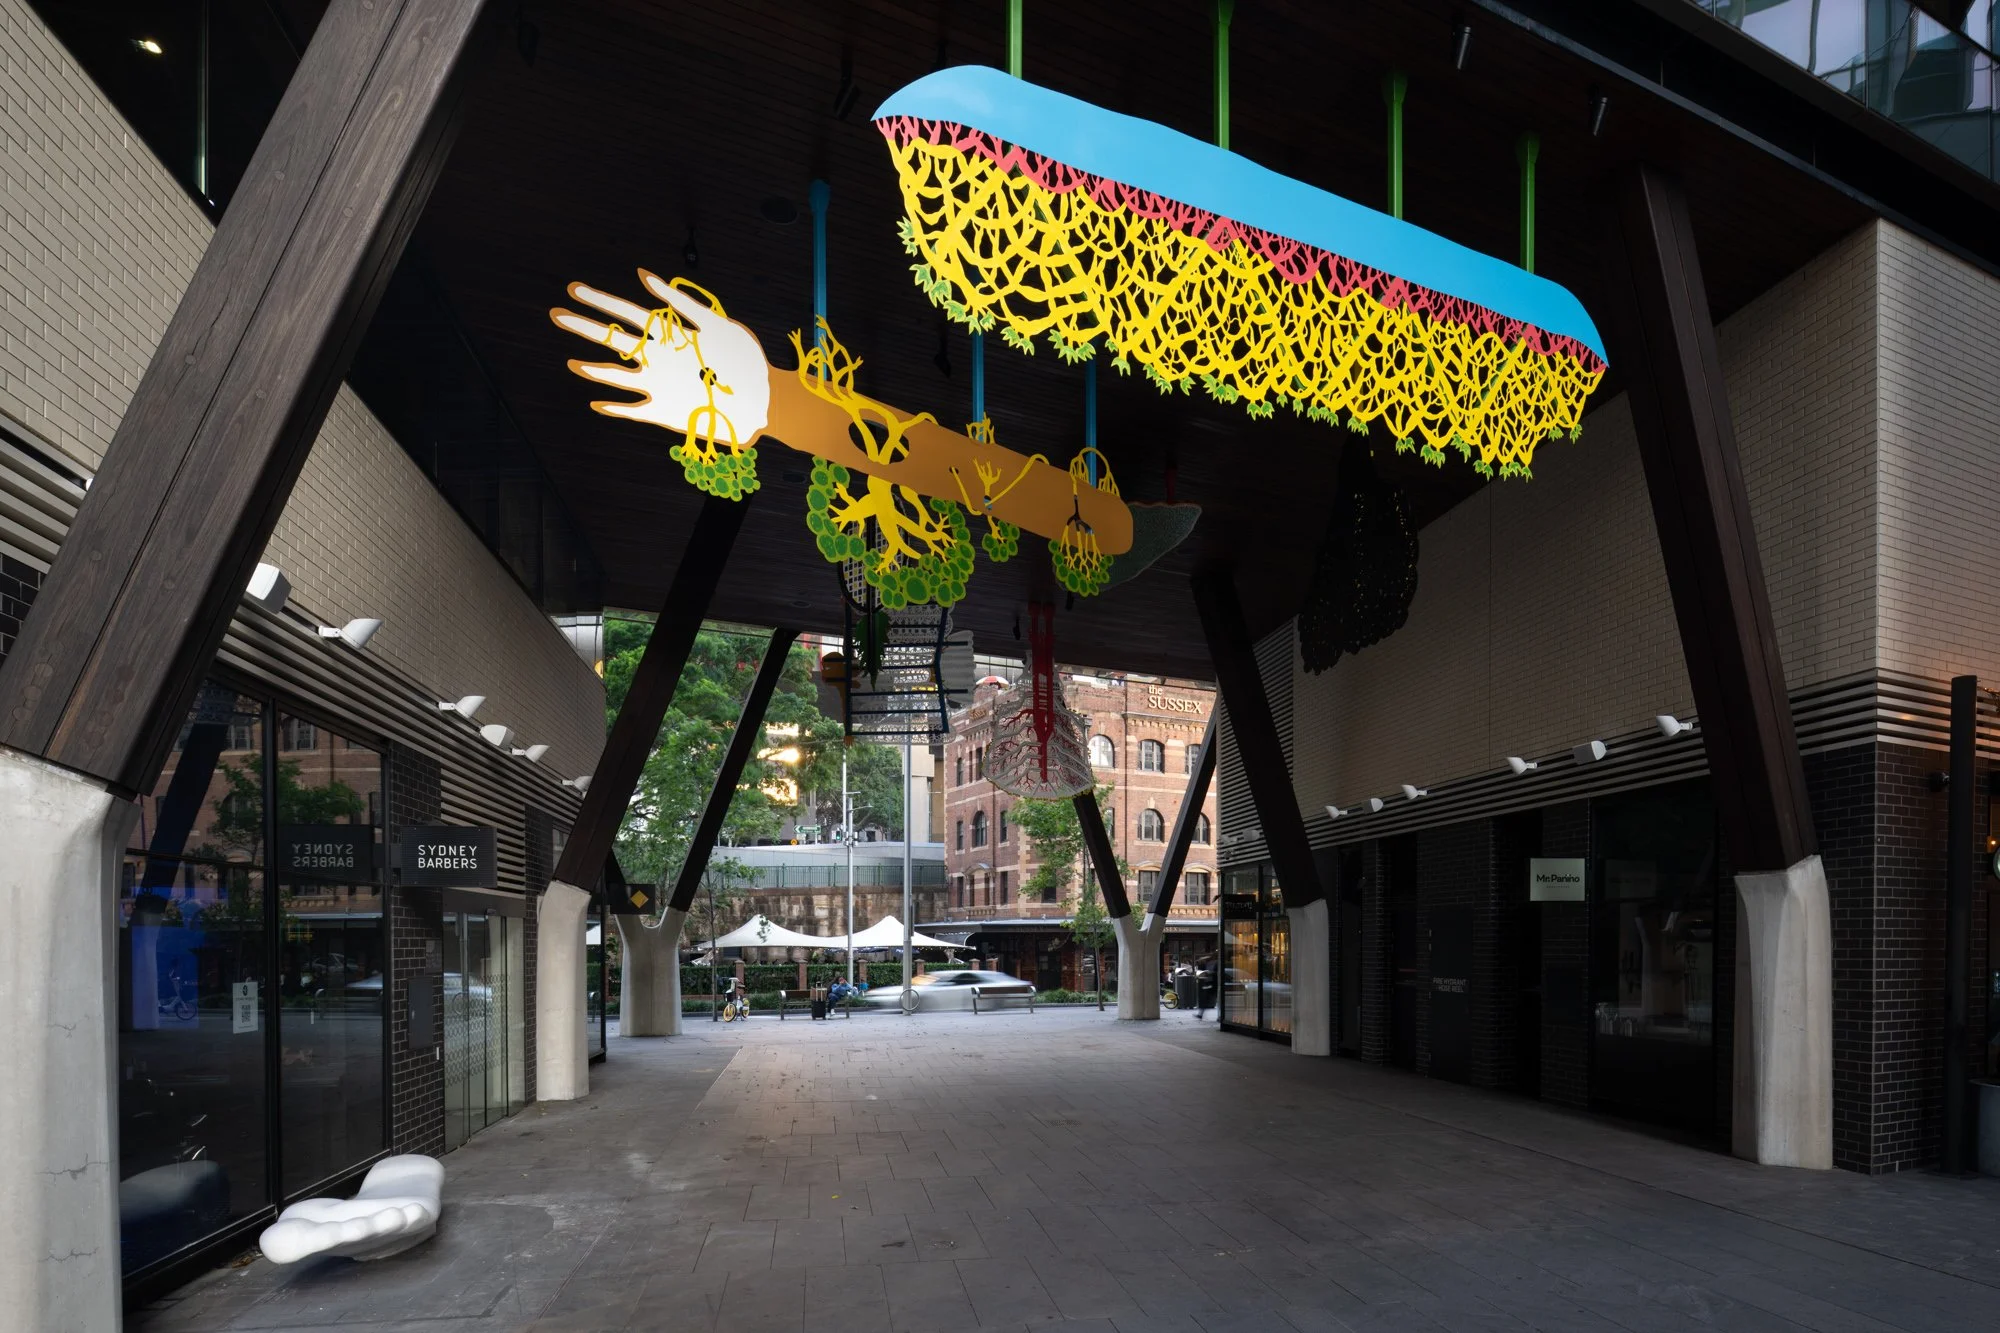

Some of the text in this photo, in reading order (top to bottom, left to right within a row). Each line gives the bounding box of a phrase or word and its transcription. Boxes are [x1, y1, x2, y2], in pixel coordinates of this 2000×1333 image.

[1148, 685, 1163, 695] the
[1148, 695, 1204, 714] SUSSEX
[417, 844, 478, 857] SYDNEY
[417, 857, 478, 869] BARBERS
[1443, 977, 1467, 986] HYDRANT
